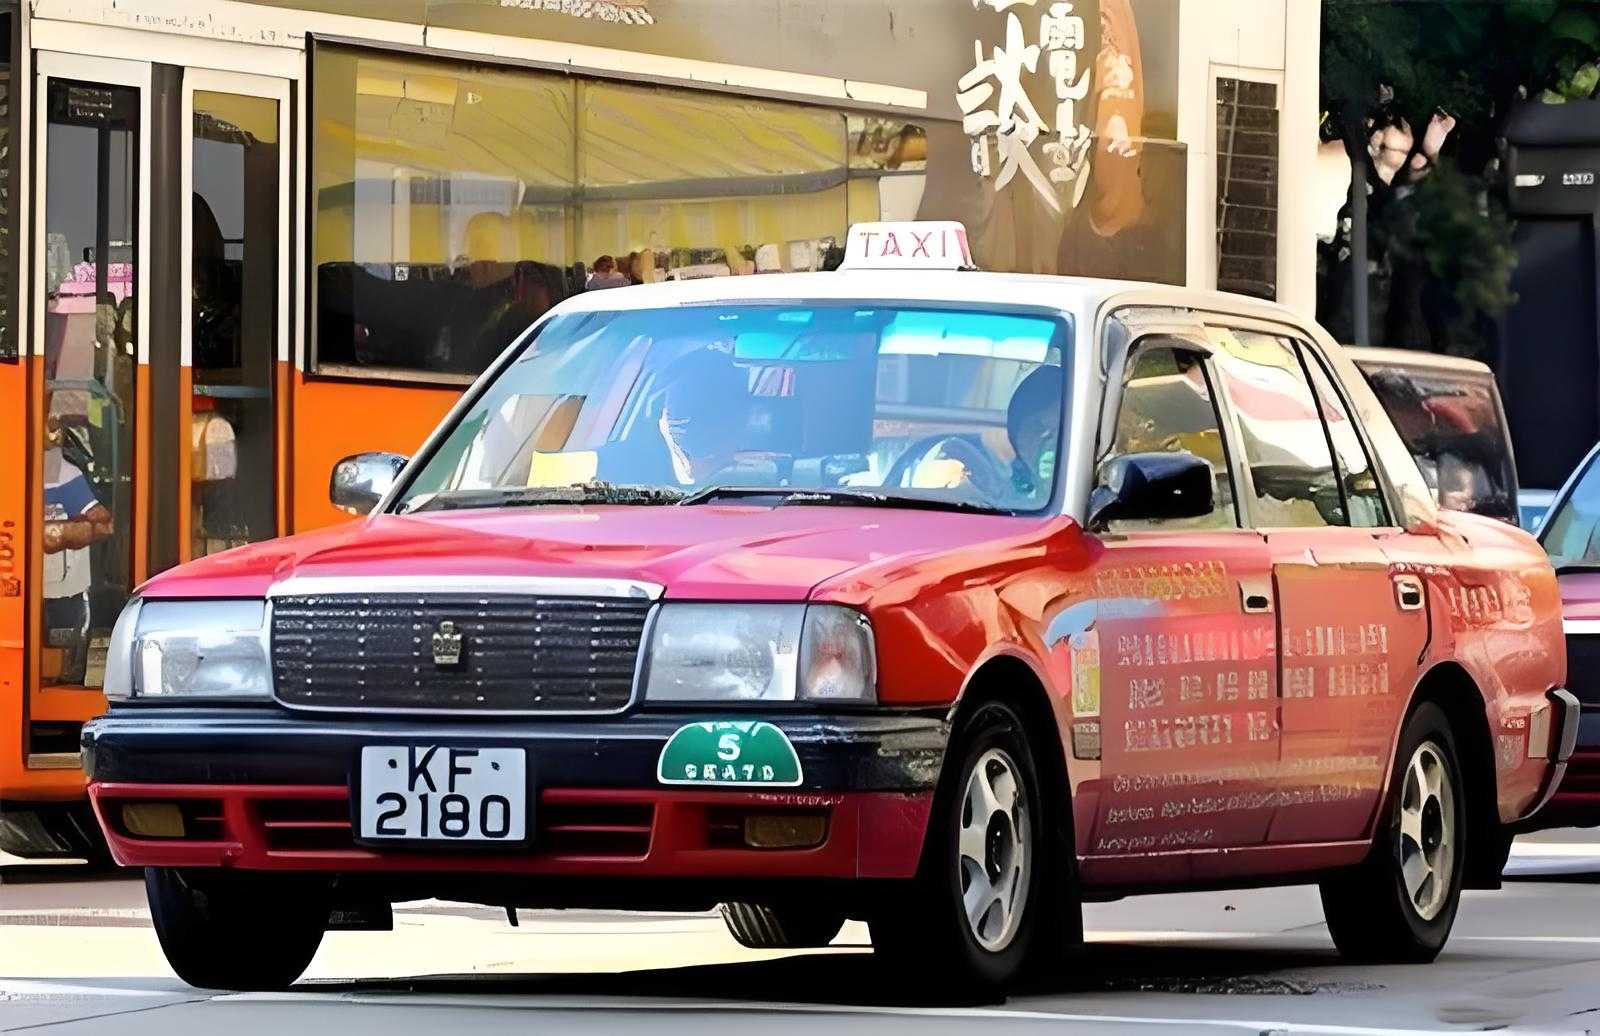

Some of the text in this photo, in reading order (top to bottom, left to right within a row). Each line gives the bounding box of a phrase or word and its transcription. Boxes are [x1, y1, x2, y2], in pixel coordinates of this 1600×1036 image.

[956, 0, 1061, 213] 談
[1040, 2, 1093, 208] 電影
[860, 230, 947, 258] TAXI
[408, 745, 479, 792] KF
[717, 733, 741, 761] 5
[376, 792, 511, 838] 2180
